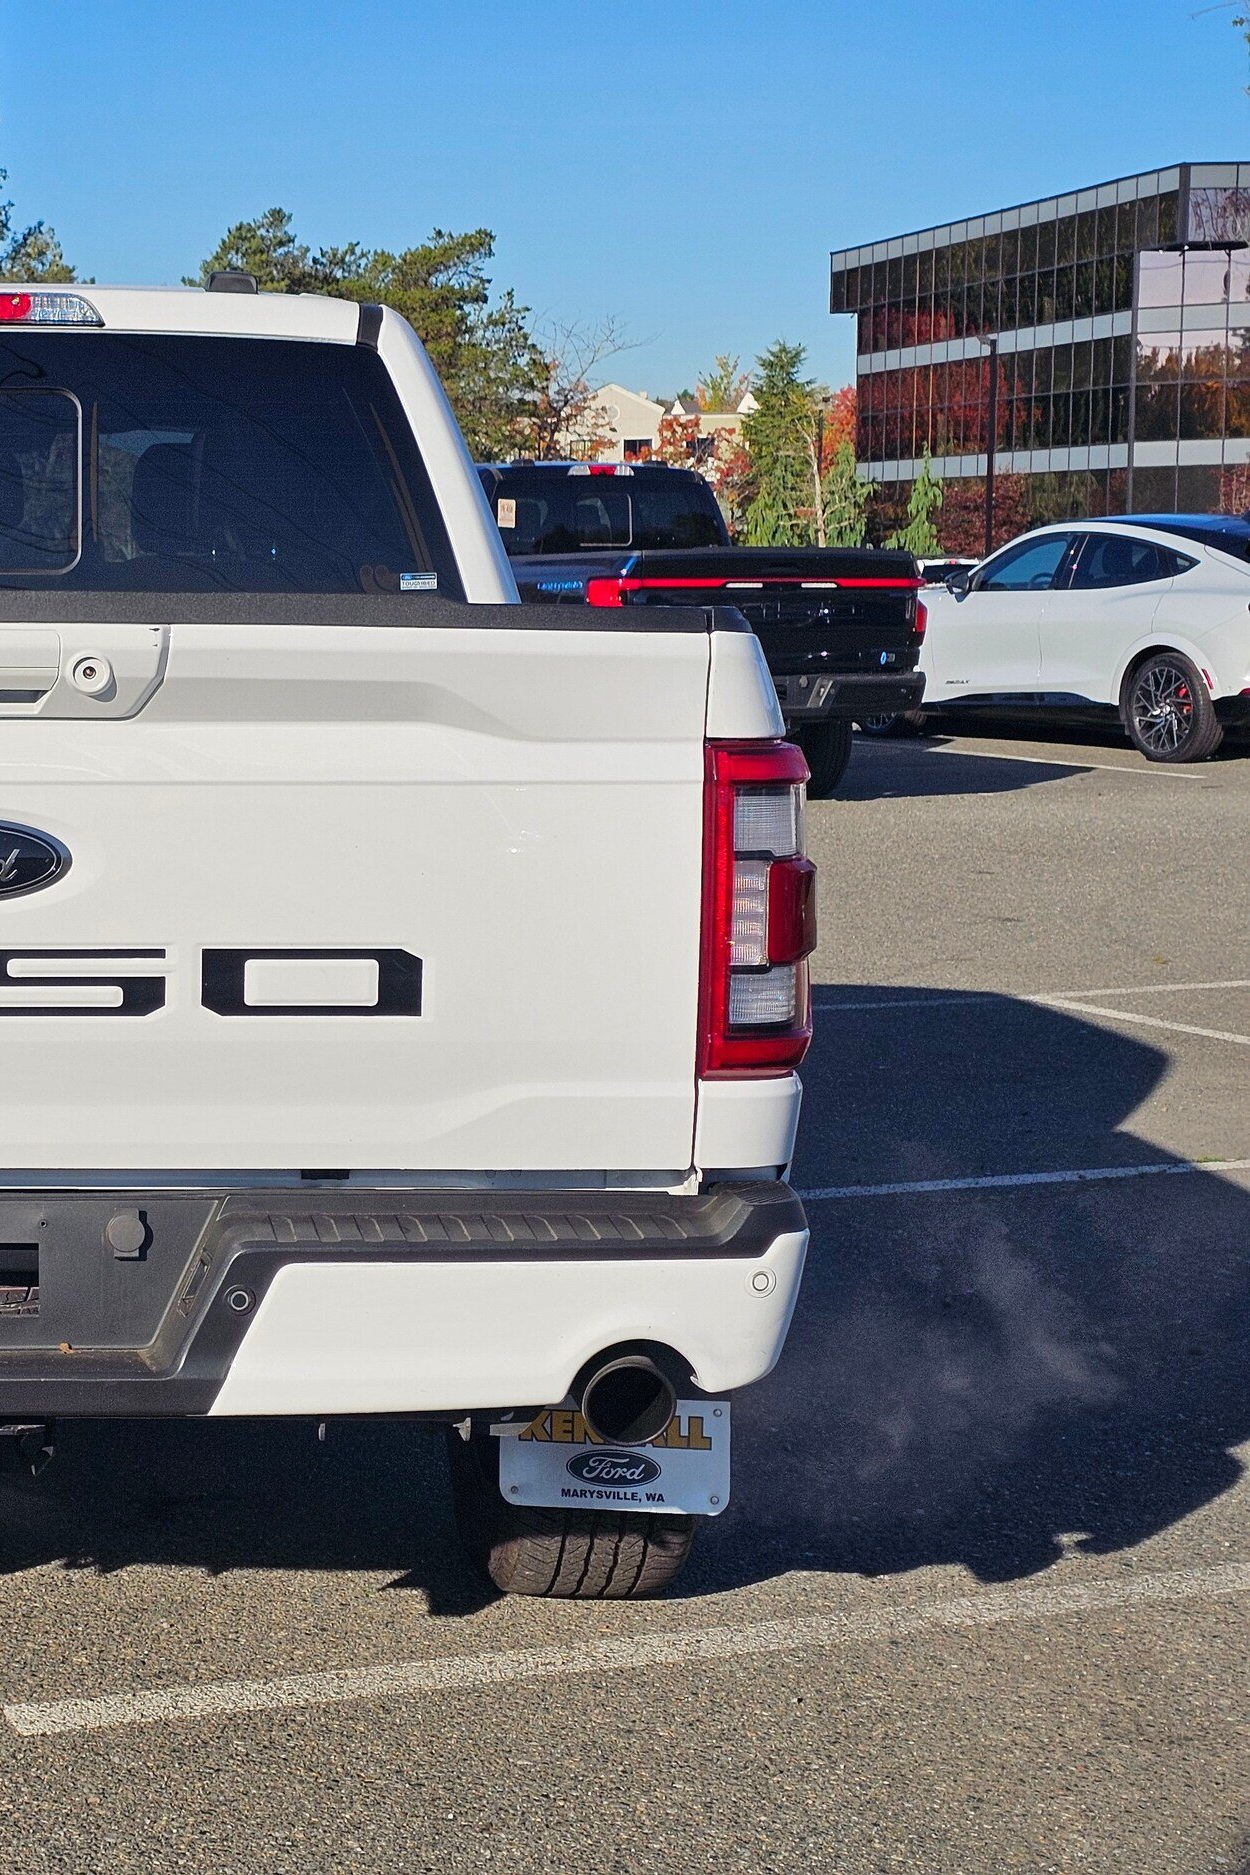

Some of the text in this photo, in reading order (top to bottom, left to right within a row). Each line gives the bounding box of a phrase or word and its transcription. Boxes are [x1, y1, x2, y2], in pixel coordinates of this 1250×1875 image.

[582, 1456, 646, 1480] Ford
[561, 1488, 665, 1503] MARYSVILLE, WA
